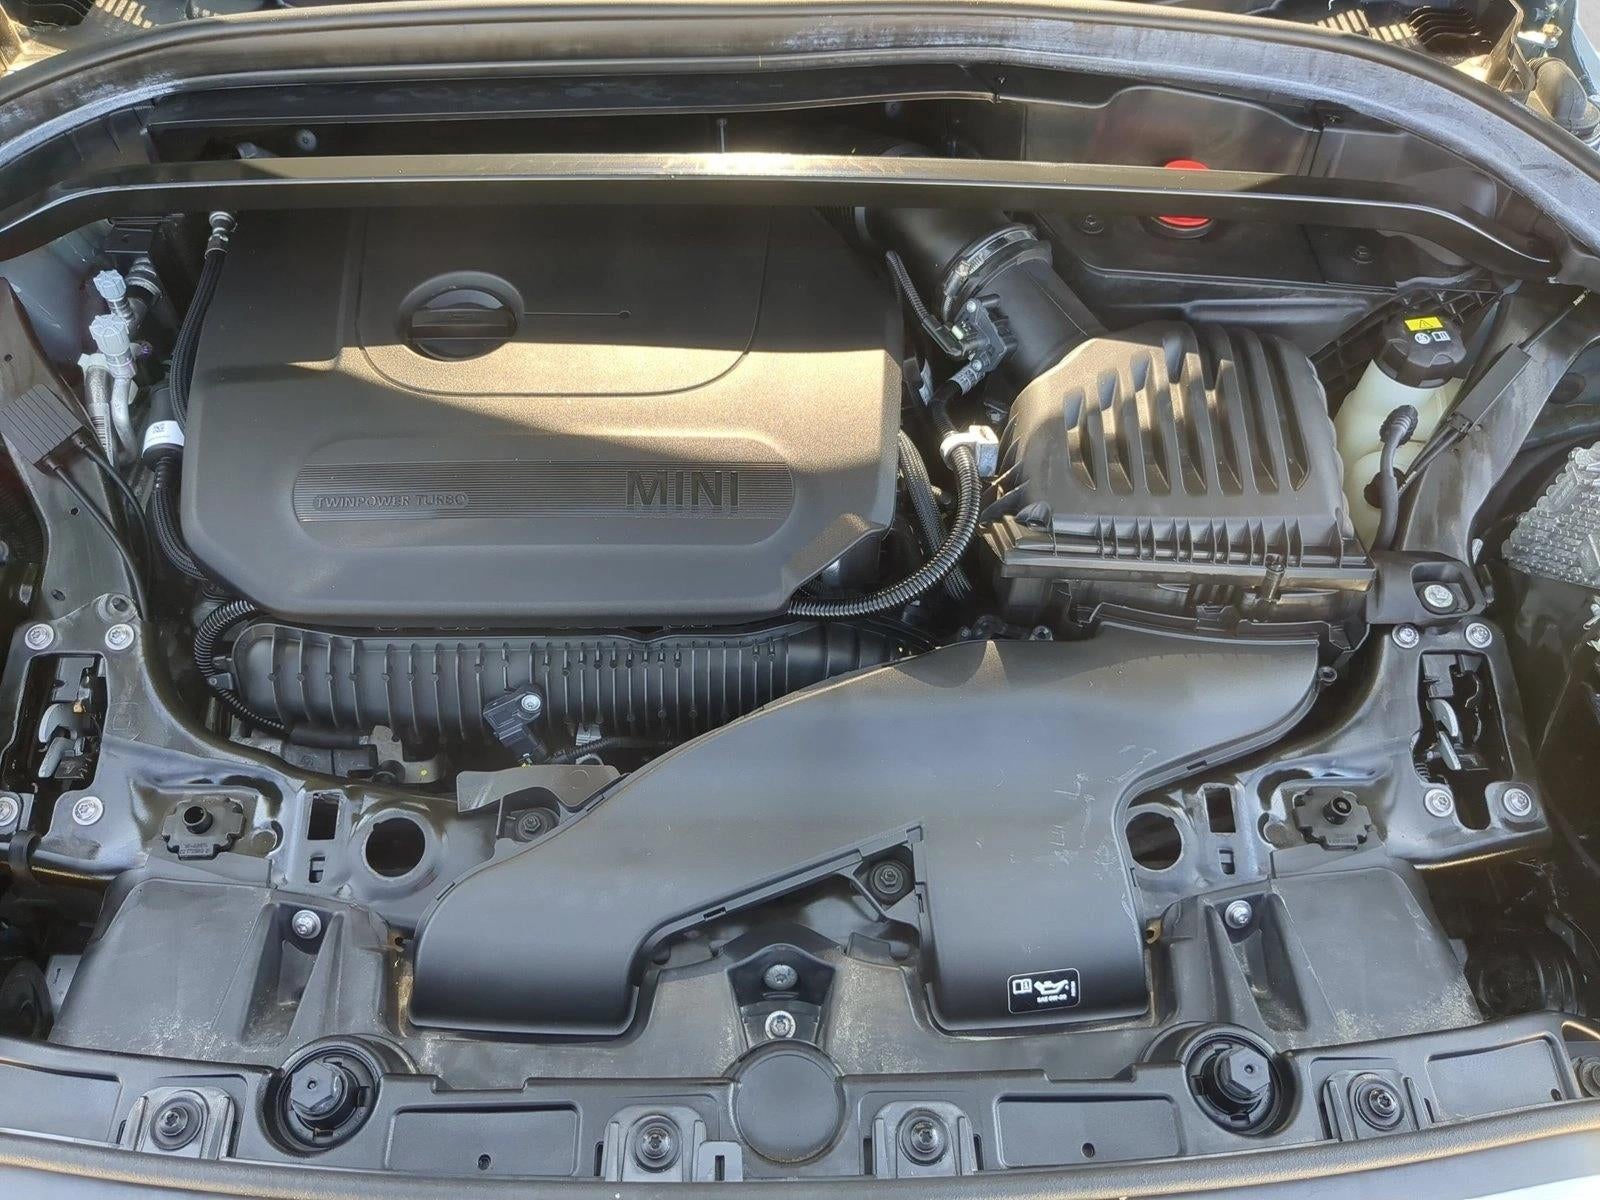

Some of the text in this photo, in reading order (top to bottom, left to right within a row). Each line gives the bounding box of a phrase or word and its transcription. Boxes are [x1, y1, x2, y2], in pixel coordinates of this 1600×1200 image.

[316, 493, 467, 508] TWINPOWER TURBO
[626, 470, 739, 507] MINI
